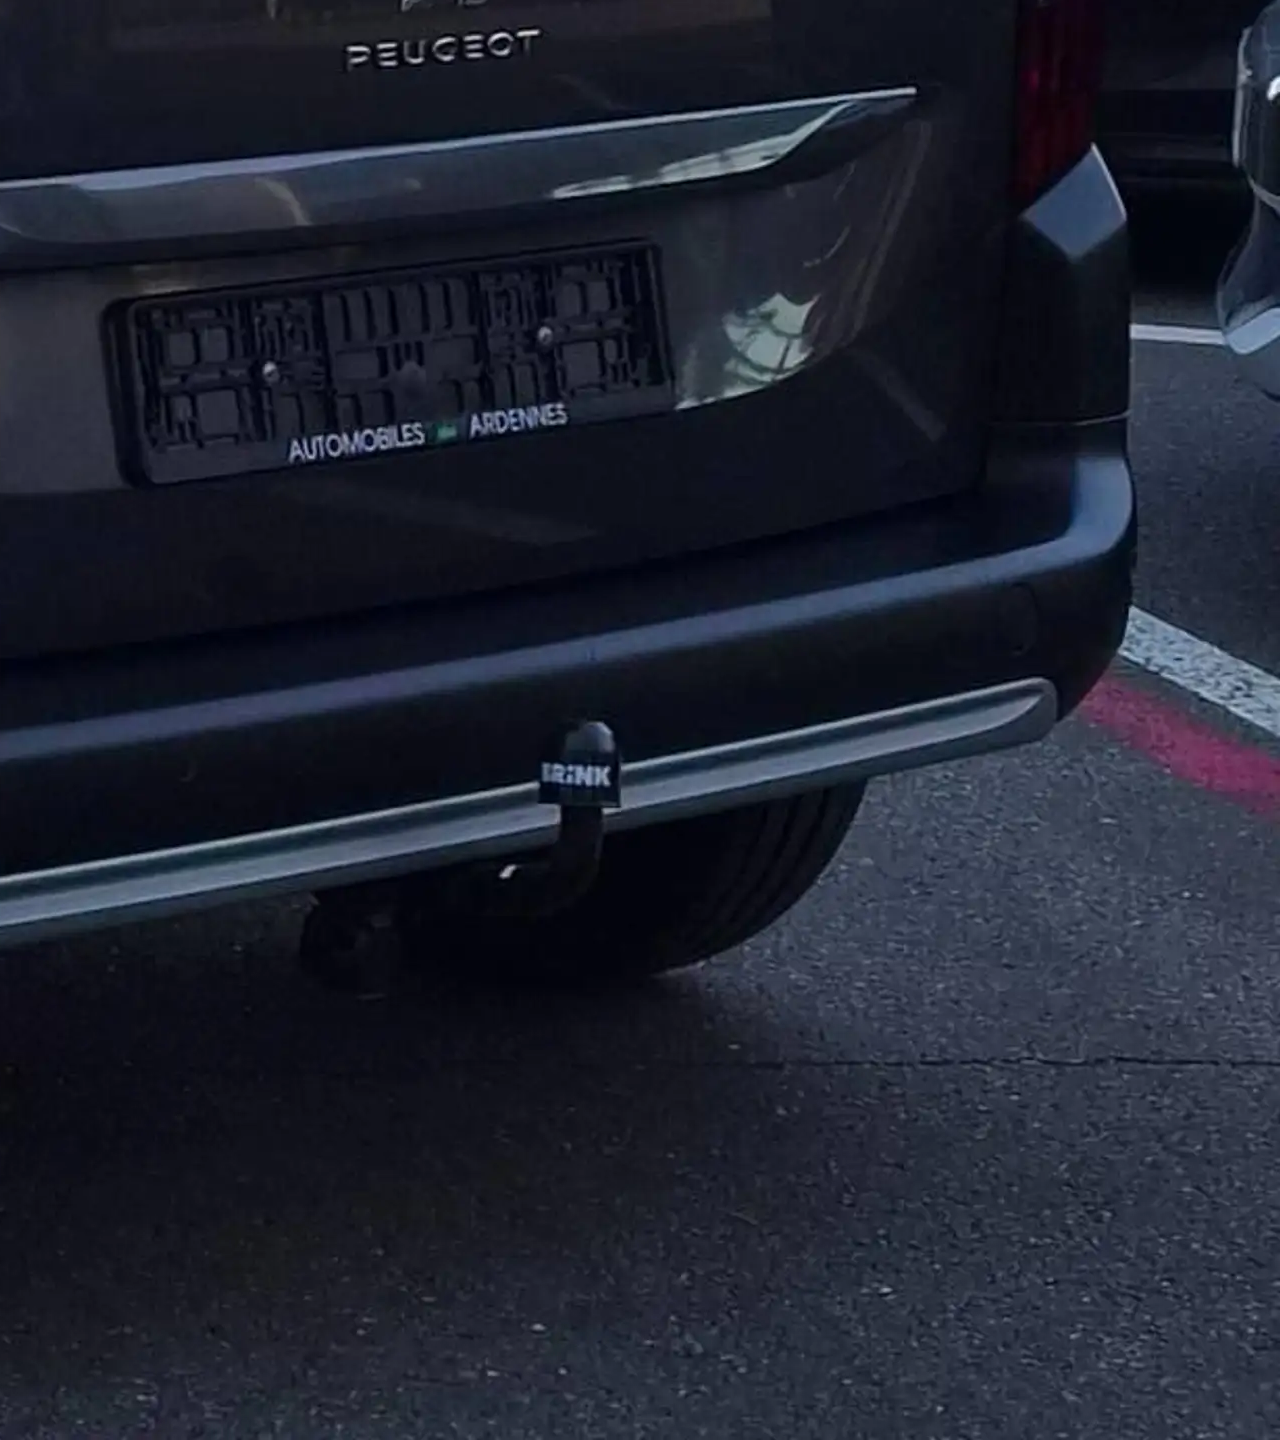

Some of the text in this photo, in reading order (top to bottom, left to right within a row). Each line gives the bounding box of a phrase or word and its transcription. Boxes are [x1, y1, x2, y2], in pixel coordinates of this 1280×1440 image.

[345, 28, 541, 72] PEUGEOT
[289, 402, 569, 463] AUTOMOBILES ARDENNES
